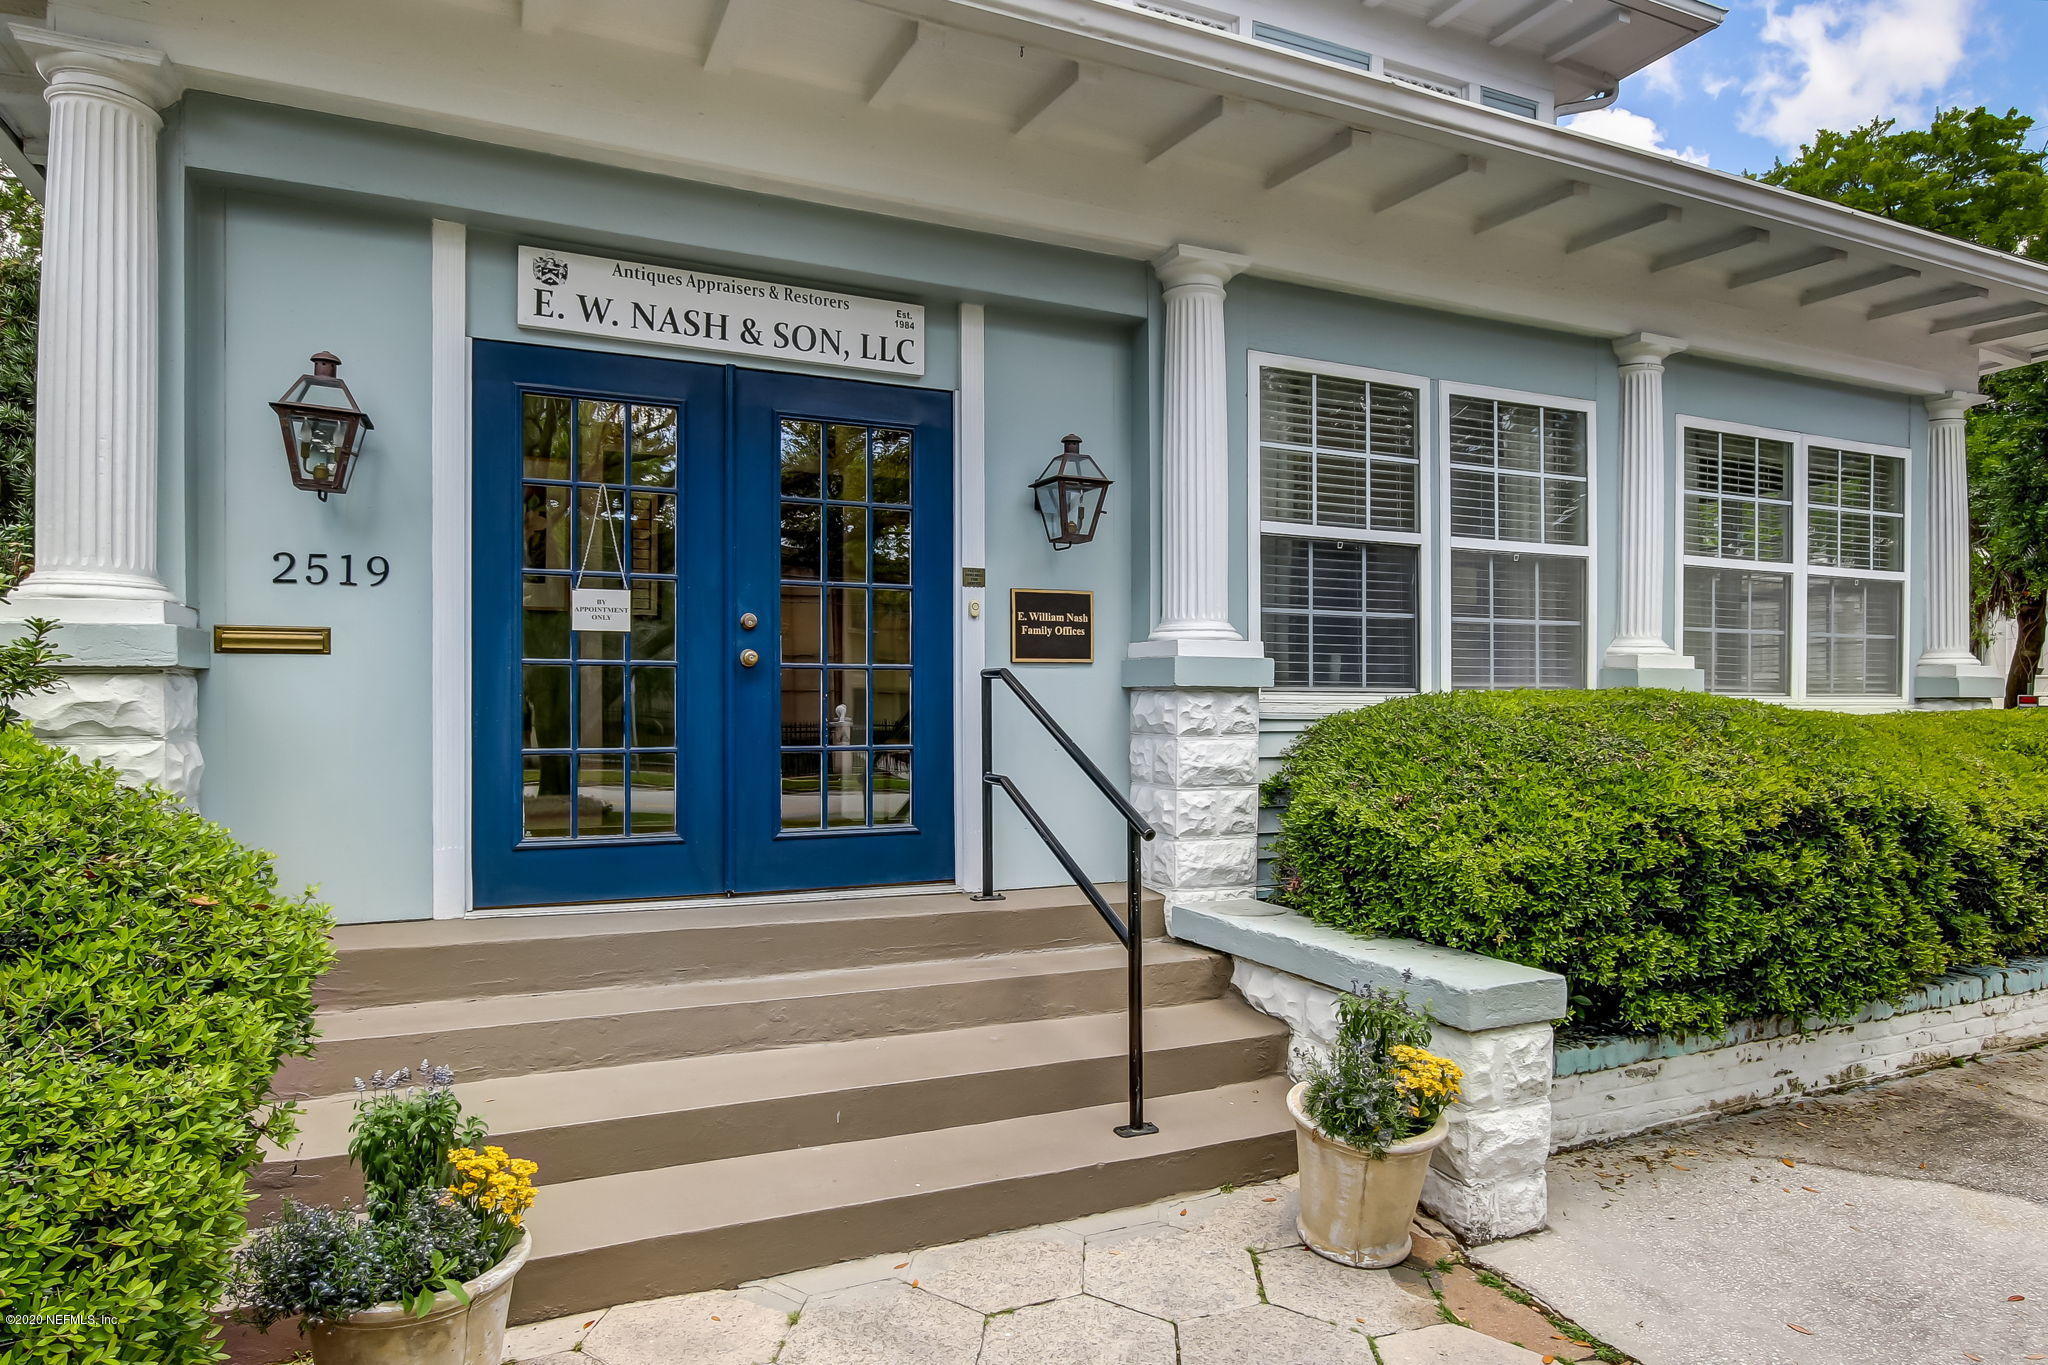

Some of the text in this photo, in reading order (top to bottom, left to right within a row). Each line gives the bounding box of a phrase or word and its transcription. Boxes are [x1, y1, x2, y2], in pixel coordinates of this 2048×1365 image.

[612, 262, 850, 310] Antiques Appraisers & Restorers
[896, 309, 913, 320] Est.
[533, 288, 916, 365] E. W. NASH & SON, LLC
[894, 320, 916, 331] 1984
[272, 552, 390, 587] 2519
[575, 606, 629, 614] APPOINTMENT
[1017, 611, 1089, 623] E. William Nash
[1021, 625, 1086, 637] Family Offices
